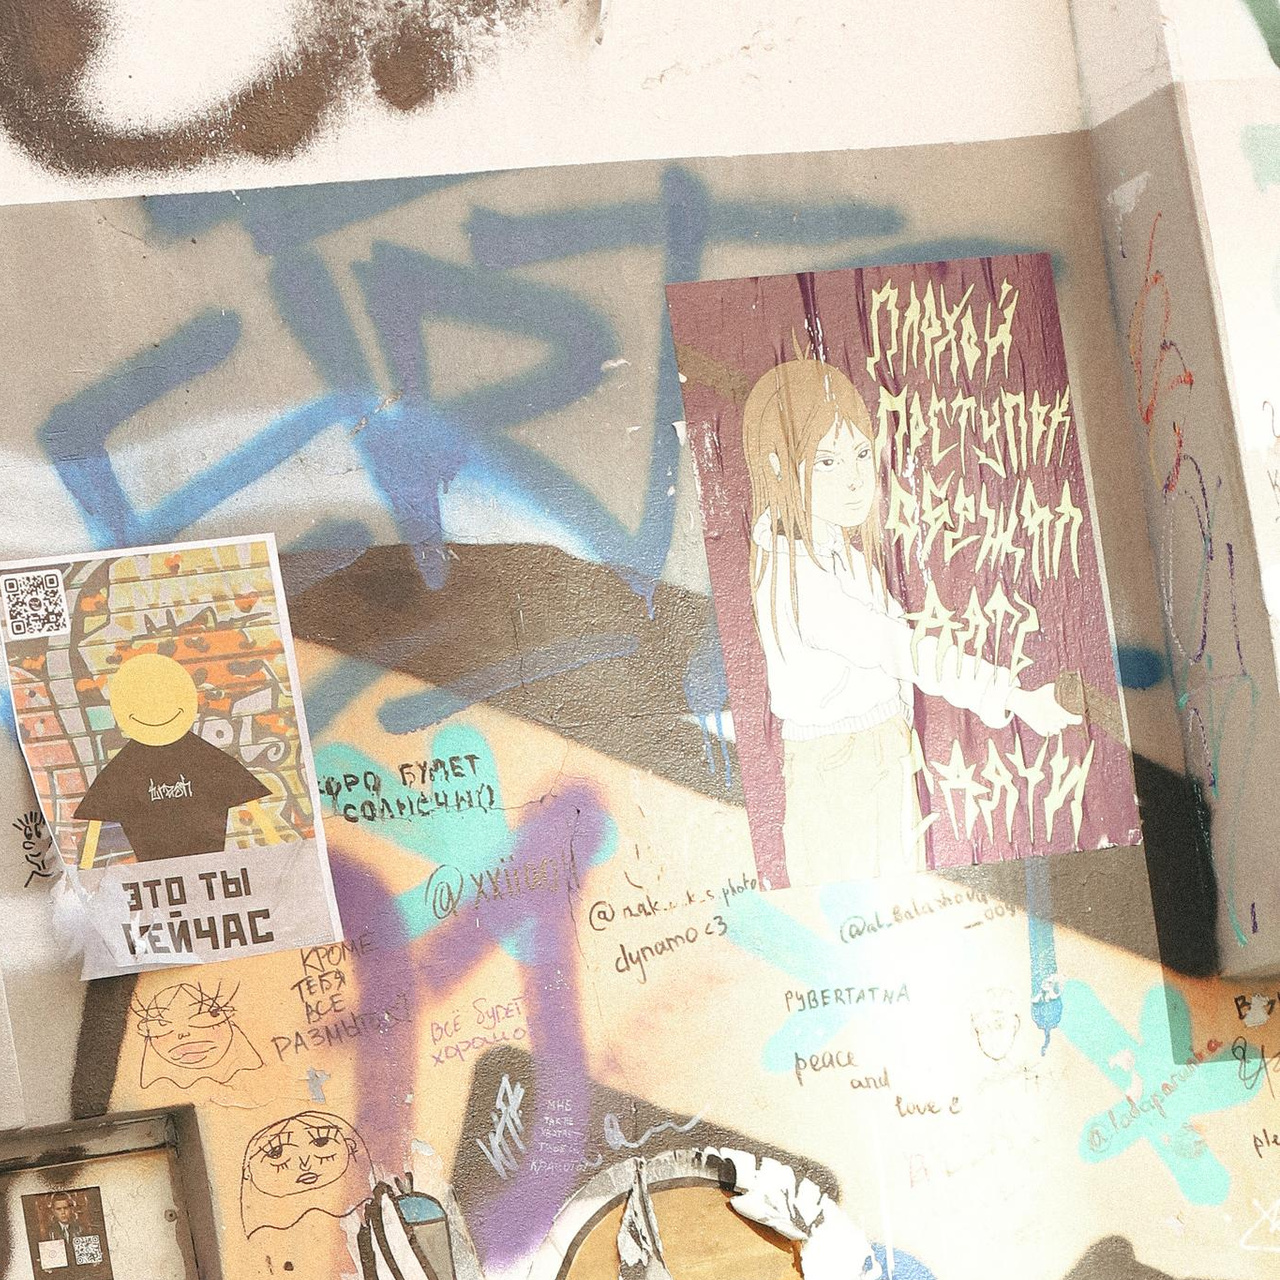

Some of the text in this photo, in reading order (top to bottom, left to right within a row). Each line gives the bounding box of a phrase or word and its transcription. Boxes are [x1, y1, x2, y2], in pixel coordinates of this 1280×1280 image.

[121, 868, 252, 912] ЭТО ТЫ
[301, 932, 376, 975] КРОМЕ
[615, 927, 699, 984] dynamo
[291, 968, 346, 1003] ТЕБЯ
[795, 1050, 859, 1086] peace
[850, 1067, 891, 1088] and
[895, 1096, 941, 1117] love
